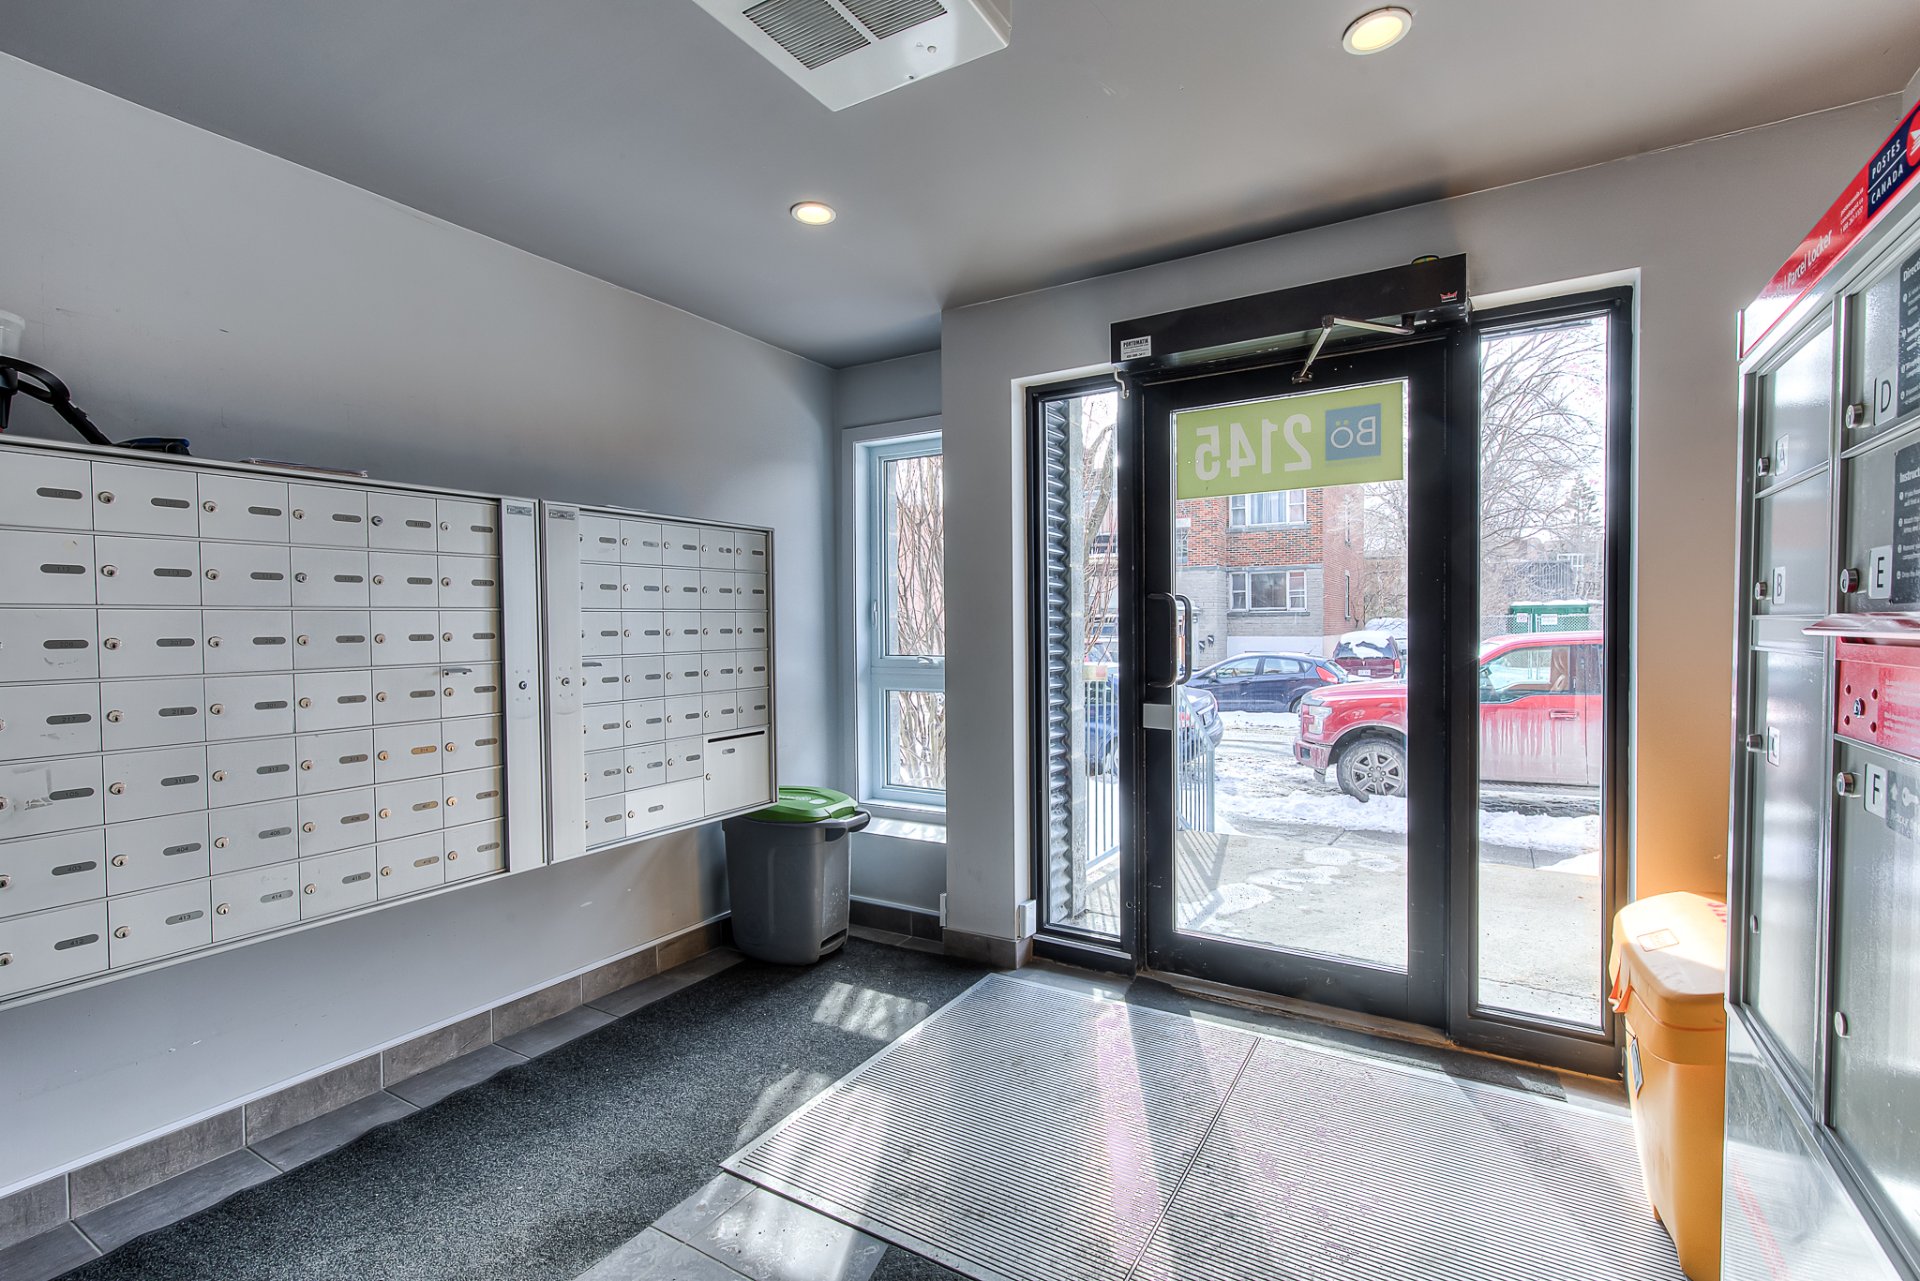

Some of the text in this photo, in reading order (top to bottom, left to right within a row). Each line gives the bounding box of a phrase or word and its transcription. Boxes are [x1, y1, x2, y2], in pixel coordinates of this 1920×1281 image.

[1871, 138, 1901, 180] POSTES
[1870, 163, 1904, 205] CANADA
[1787, 229, 1833, 290] Parcel Locker
[1880, 379, 1892, 413] D
[1777, 573, 1783, 597] B
[1876, 556, 1885, 588] E
[1872, 773, 1881, 805] F
[176, 845, 189, 854] 404
[271, 892, 282, 900] 414
[178, 913, 190, 922] 413
